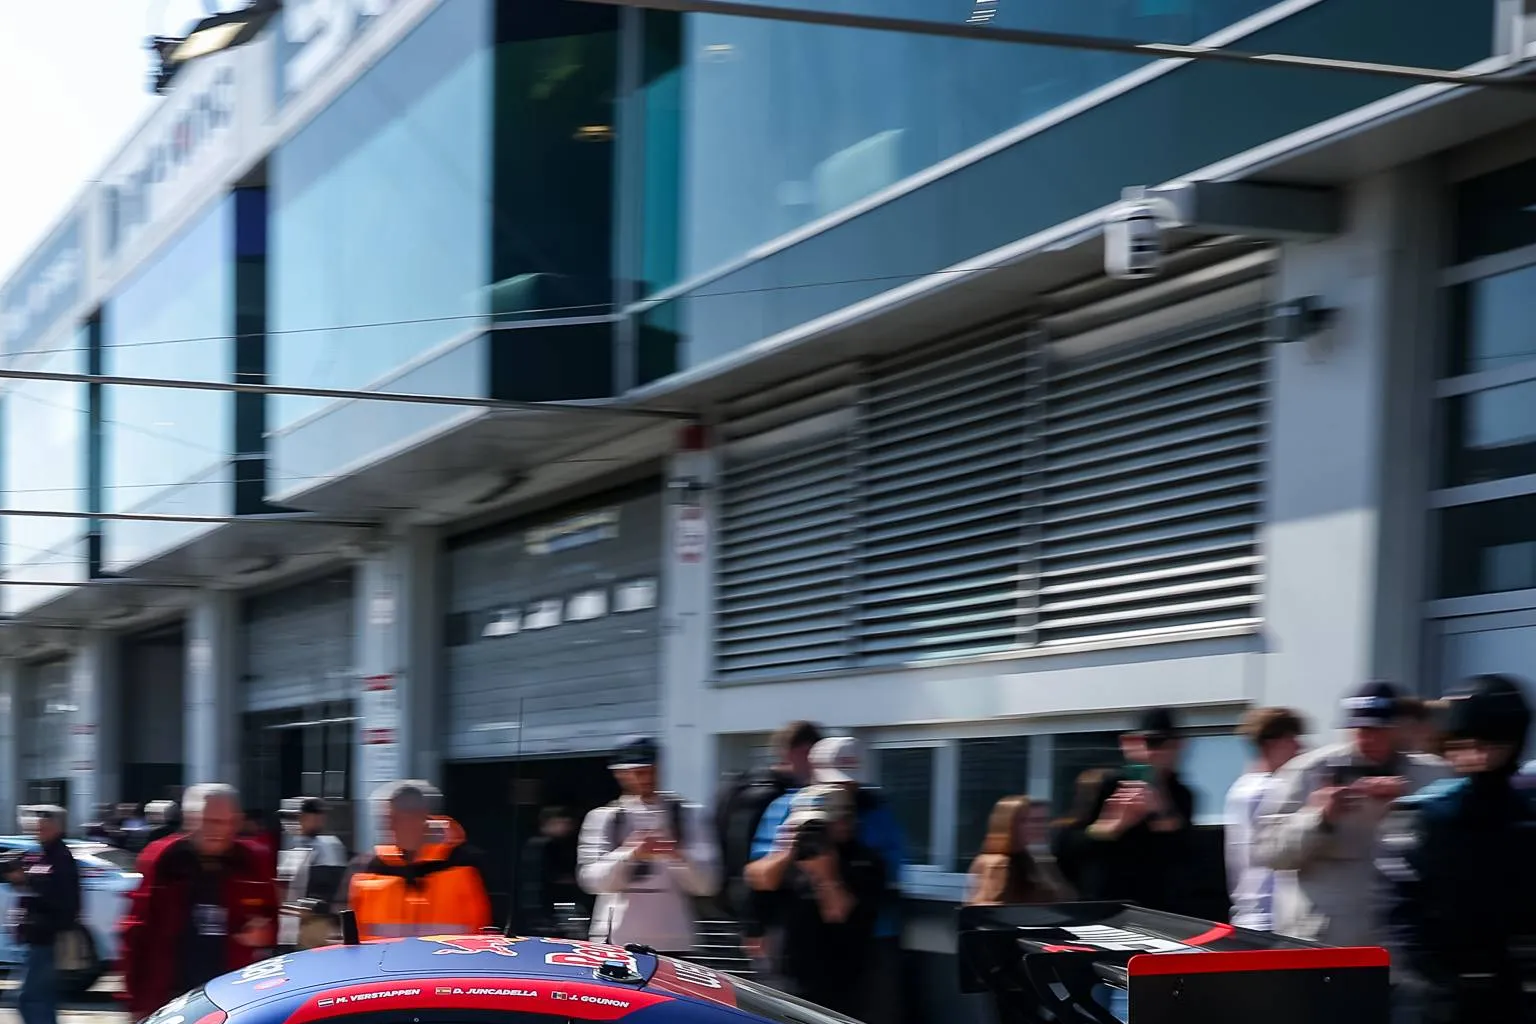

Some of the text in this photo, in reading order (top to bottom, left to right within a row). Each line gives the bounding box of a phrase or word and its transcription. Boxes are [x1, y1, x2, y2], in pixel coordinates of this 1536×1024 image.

[350, 989, 420, 1001] VERSTAPPEN
[465, 988, 538, 997] JUNCADELLA
[580, 995, 630, 1008] GOUNON
